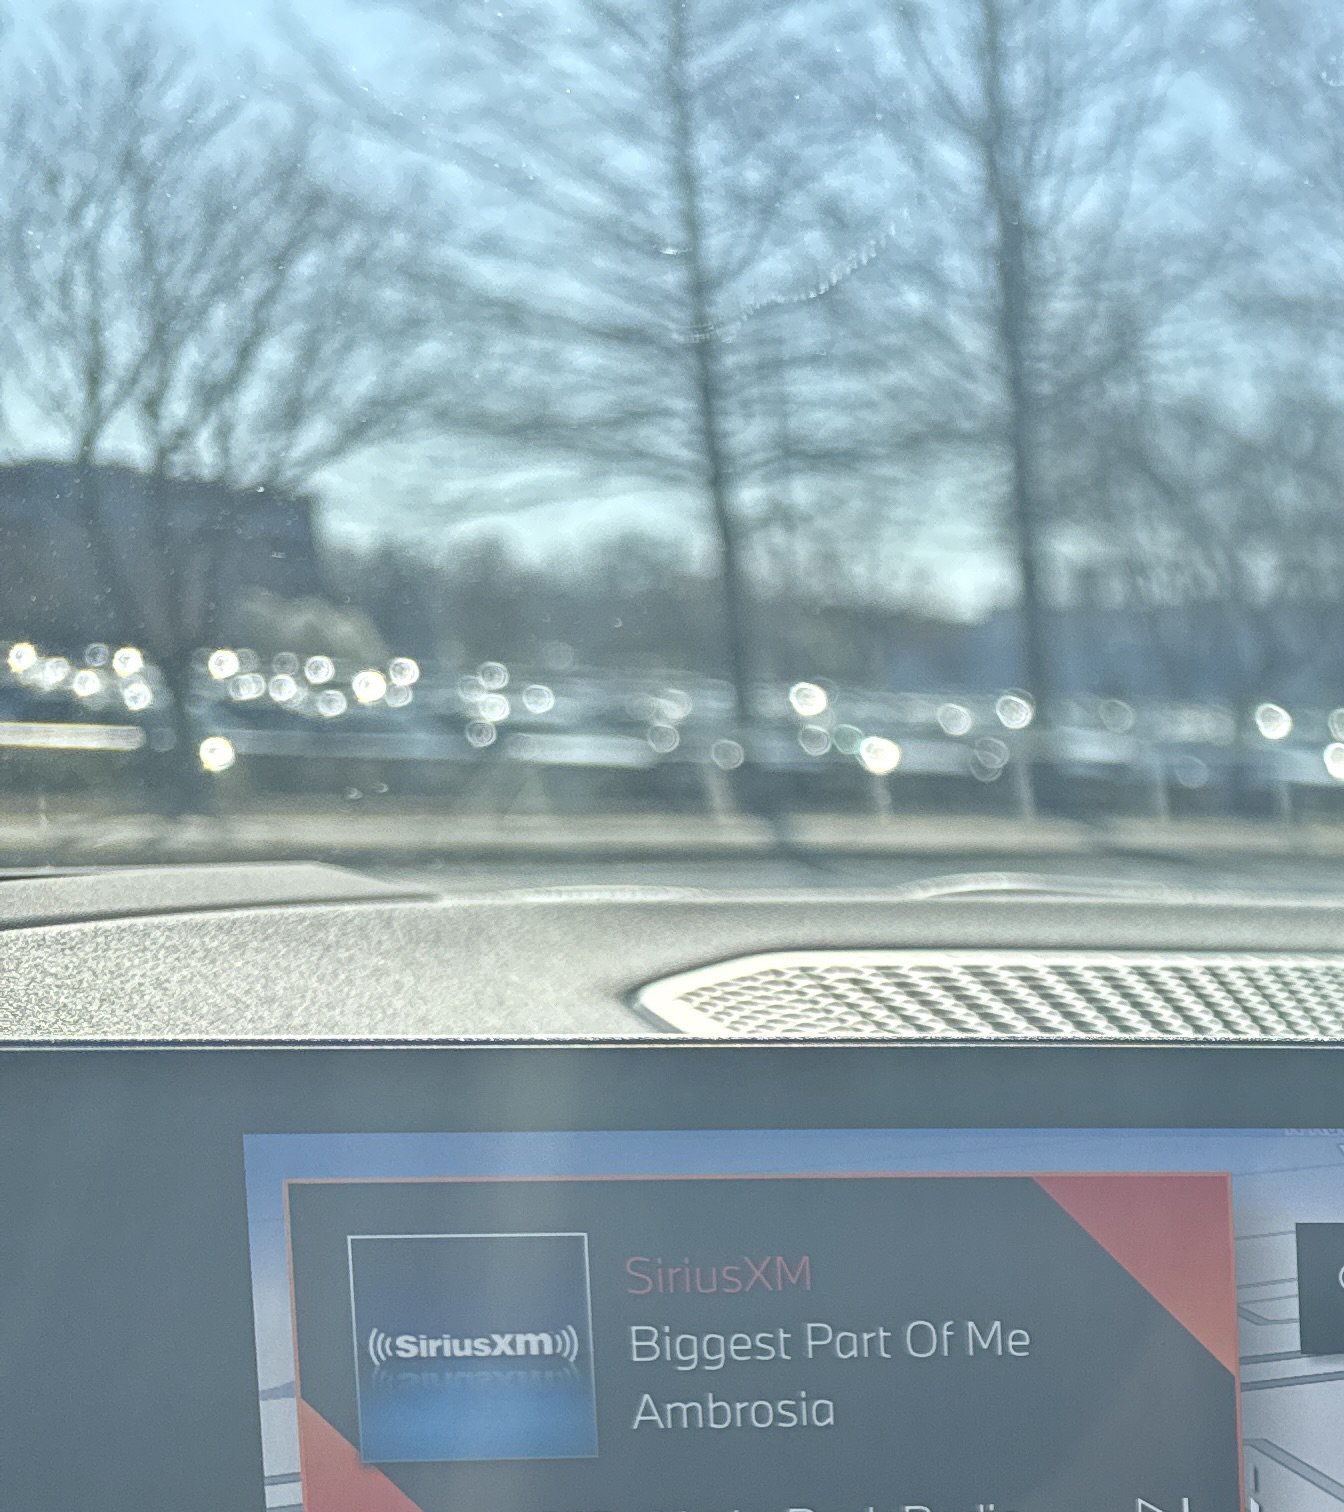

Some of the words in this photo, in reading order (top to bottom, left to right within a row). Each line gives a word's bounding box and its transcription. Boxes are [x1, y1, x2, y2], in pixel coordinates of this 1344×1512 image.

[624, 1253, 813, 1296] SiriusXM
[630, 1324, 792, 1371] Biggest
[806, 1322, 892, 1359] Part
[905, 1319, 957, 1358] Of
[966, 1319, 1031, 1357] Me
[632, 1390, 835, 1432] Ambrosia
